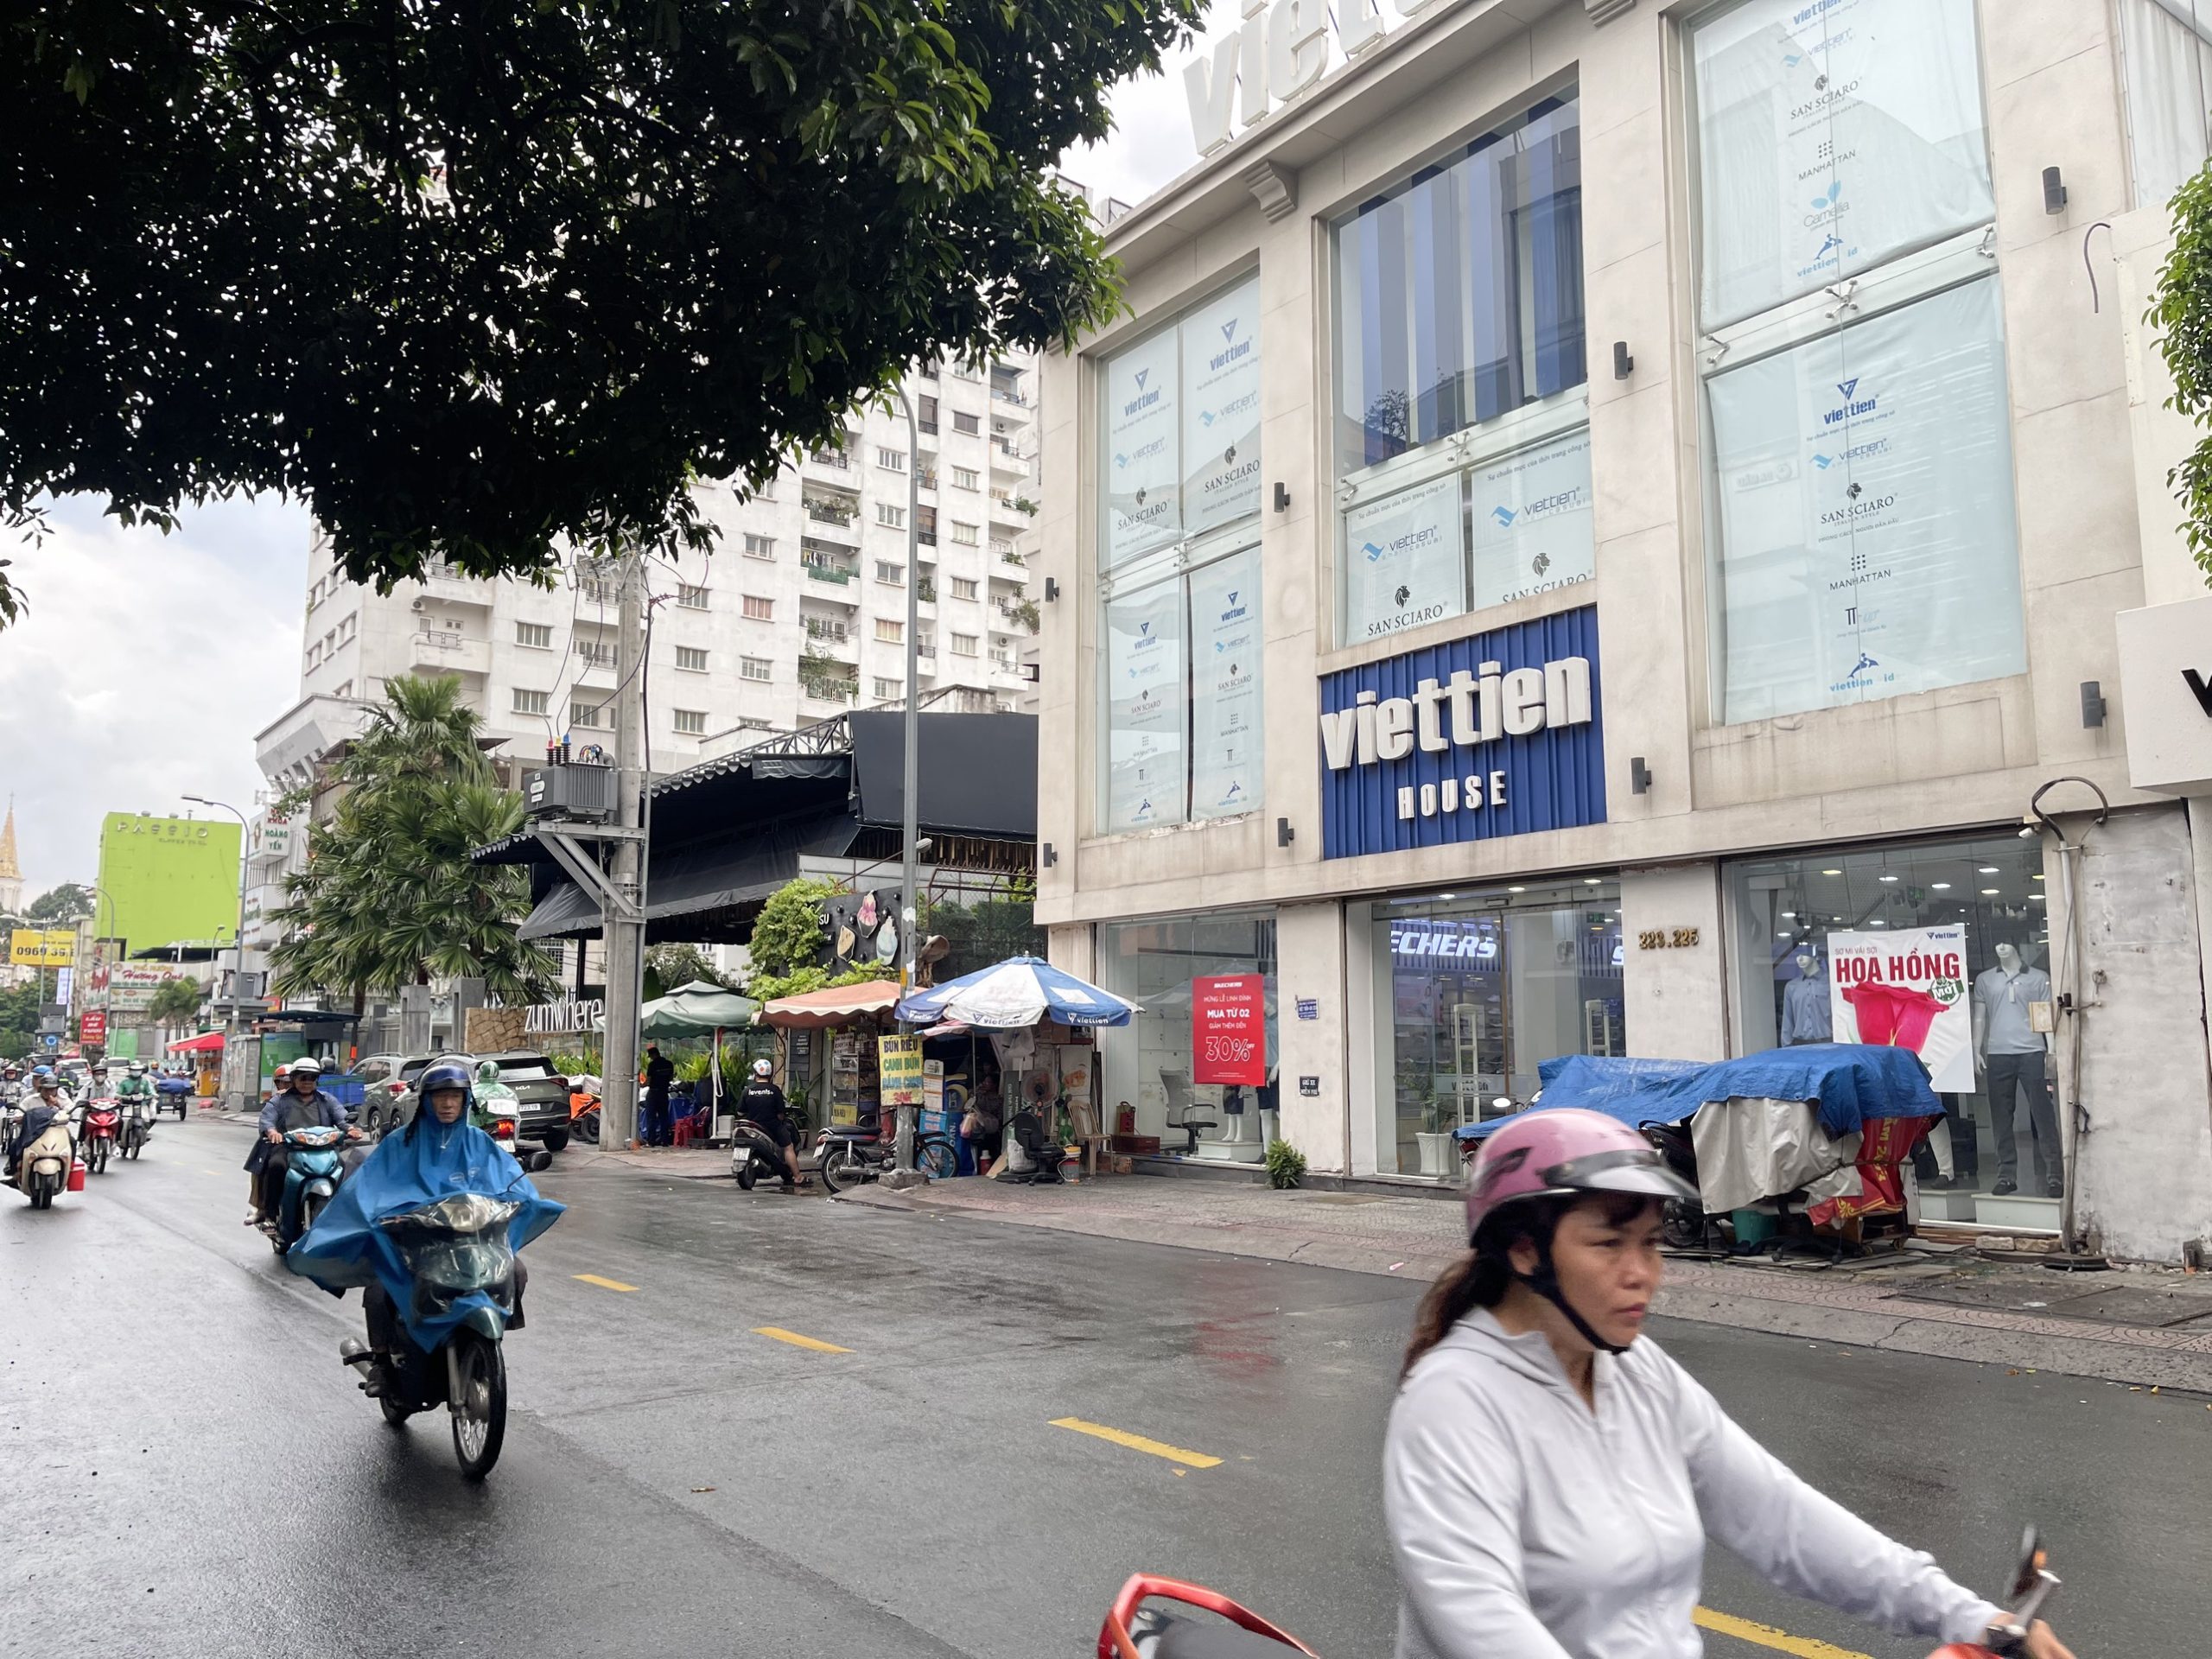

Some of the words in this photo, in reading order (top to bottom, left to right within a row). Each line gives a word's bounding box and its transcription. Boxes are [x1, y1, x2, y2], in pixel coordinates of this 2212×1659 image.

[1790, 101, 1813, 119] SAN
[1815, 80, 1859, 109] SCIARO
[1798, 149, 1856, 181] MANHATTAN
[1210, 340, 1249, 372] viettien
[1124, 390, 1159, 416] viettien
[1823, 399, 1876, 425] viettien
[1839, 440, 1884, 461] viettien
[1204, 476, 1223, 493] SAN
[1224, 460, 1260, 484] SCIARO
[1118, 515, 1134, 531] SAN
[1135, 501, 1167, 524] SCIARO
[1524, 489, 1576, 516] viettien
[1821, 509, 1845, 524] SAN
[1847, 496, 1894, 517] SCIARO
[1389, 527, 1433, 551] viettien
[1829, 569, 1891, 591] MANHATTAN
[1368, 618, 1391, 636] SAN
[1395, 604, 1443, 629] SCIARO
[1829, 678, 1873, 692] viettien
[1320, 656, 1592, 771] viettien
[1398, 770, 1507, 820] HOUSE
[1835, 957, 1883, 983] HOA
[1889, 947, 1961, 982] HỒNG
[524, 986, 603, 1033] zumwhere
[1207, 1009, 1225, 1018] MUA
[1226, 1007, 1238, 1018] TỪ
[1239, 1009, 1250, 1018] 02
[884, 1037, 899, 1052] BÚN
[900, 1036, 918, 1052] RIÊU
[1205, 1035, 1250, 1062] 30%
[884, 1058, 902, 1071] CANH
[904, 1054, 920, 1070] BÚN
